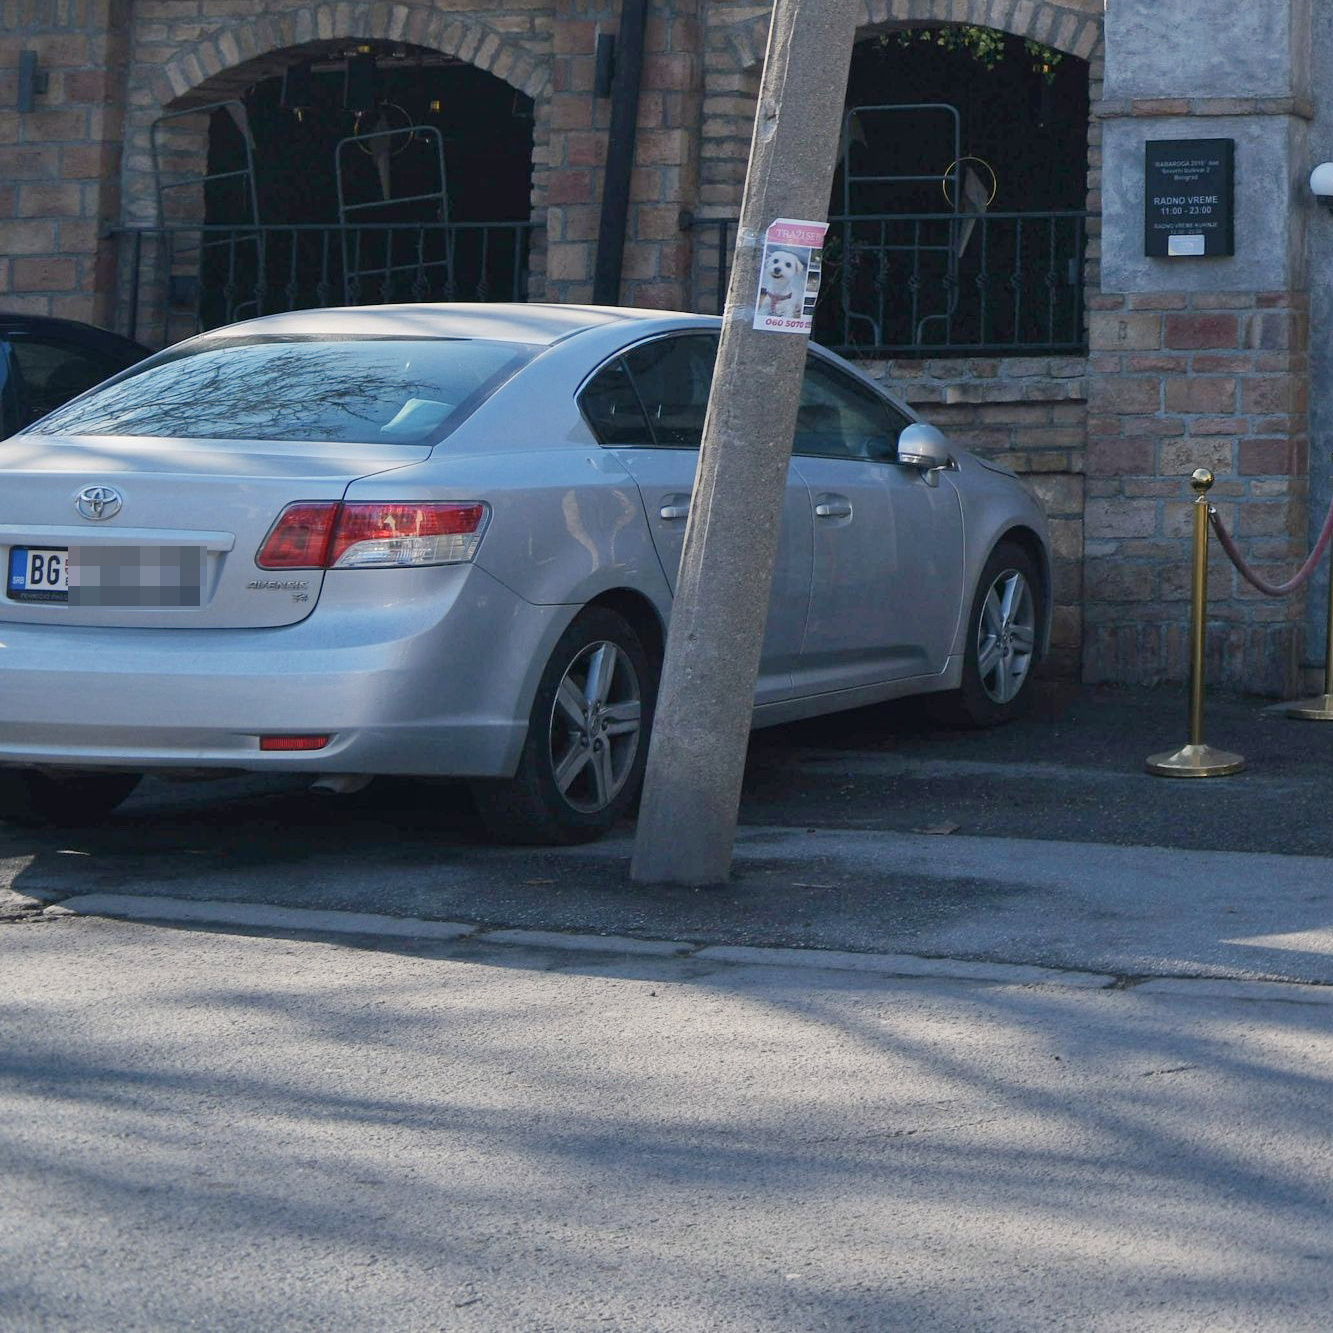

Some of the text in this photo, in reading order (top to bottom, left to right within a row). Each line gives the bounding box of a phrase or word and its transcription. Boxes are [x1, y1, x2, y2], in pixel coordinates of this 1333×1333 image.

[1154, 195, 1219, 205] RADNO VREME
[1189, 206, 1212, 215] 23:00
[30, 554, 61, 585] BG
[246, 580, 309, 589] AVENSIS
